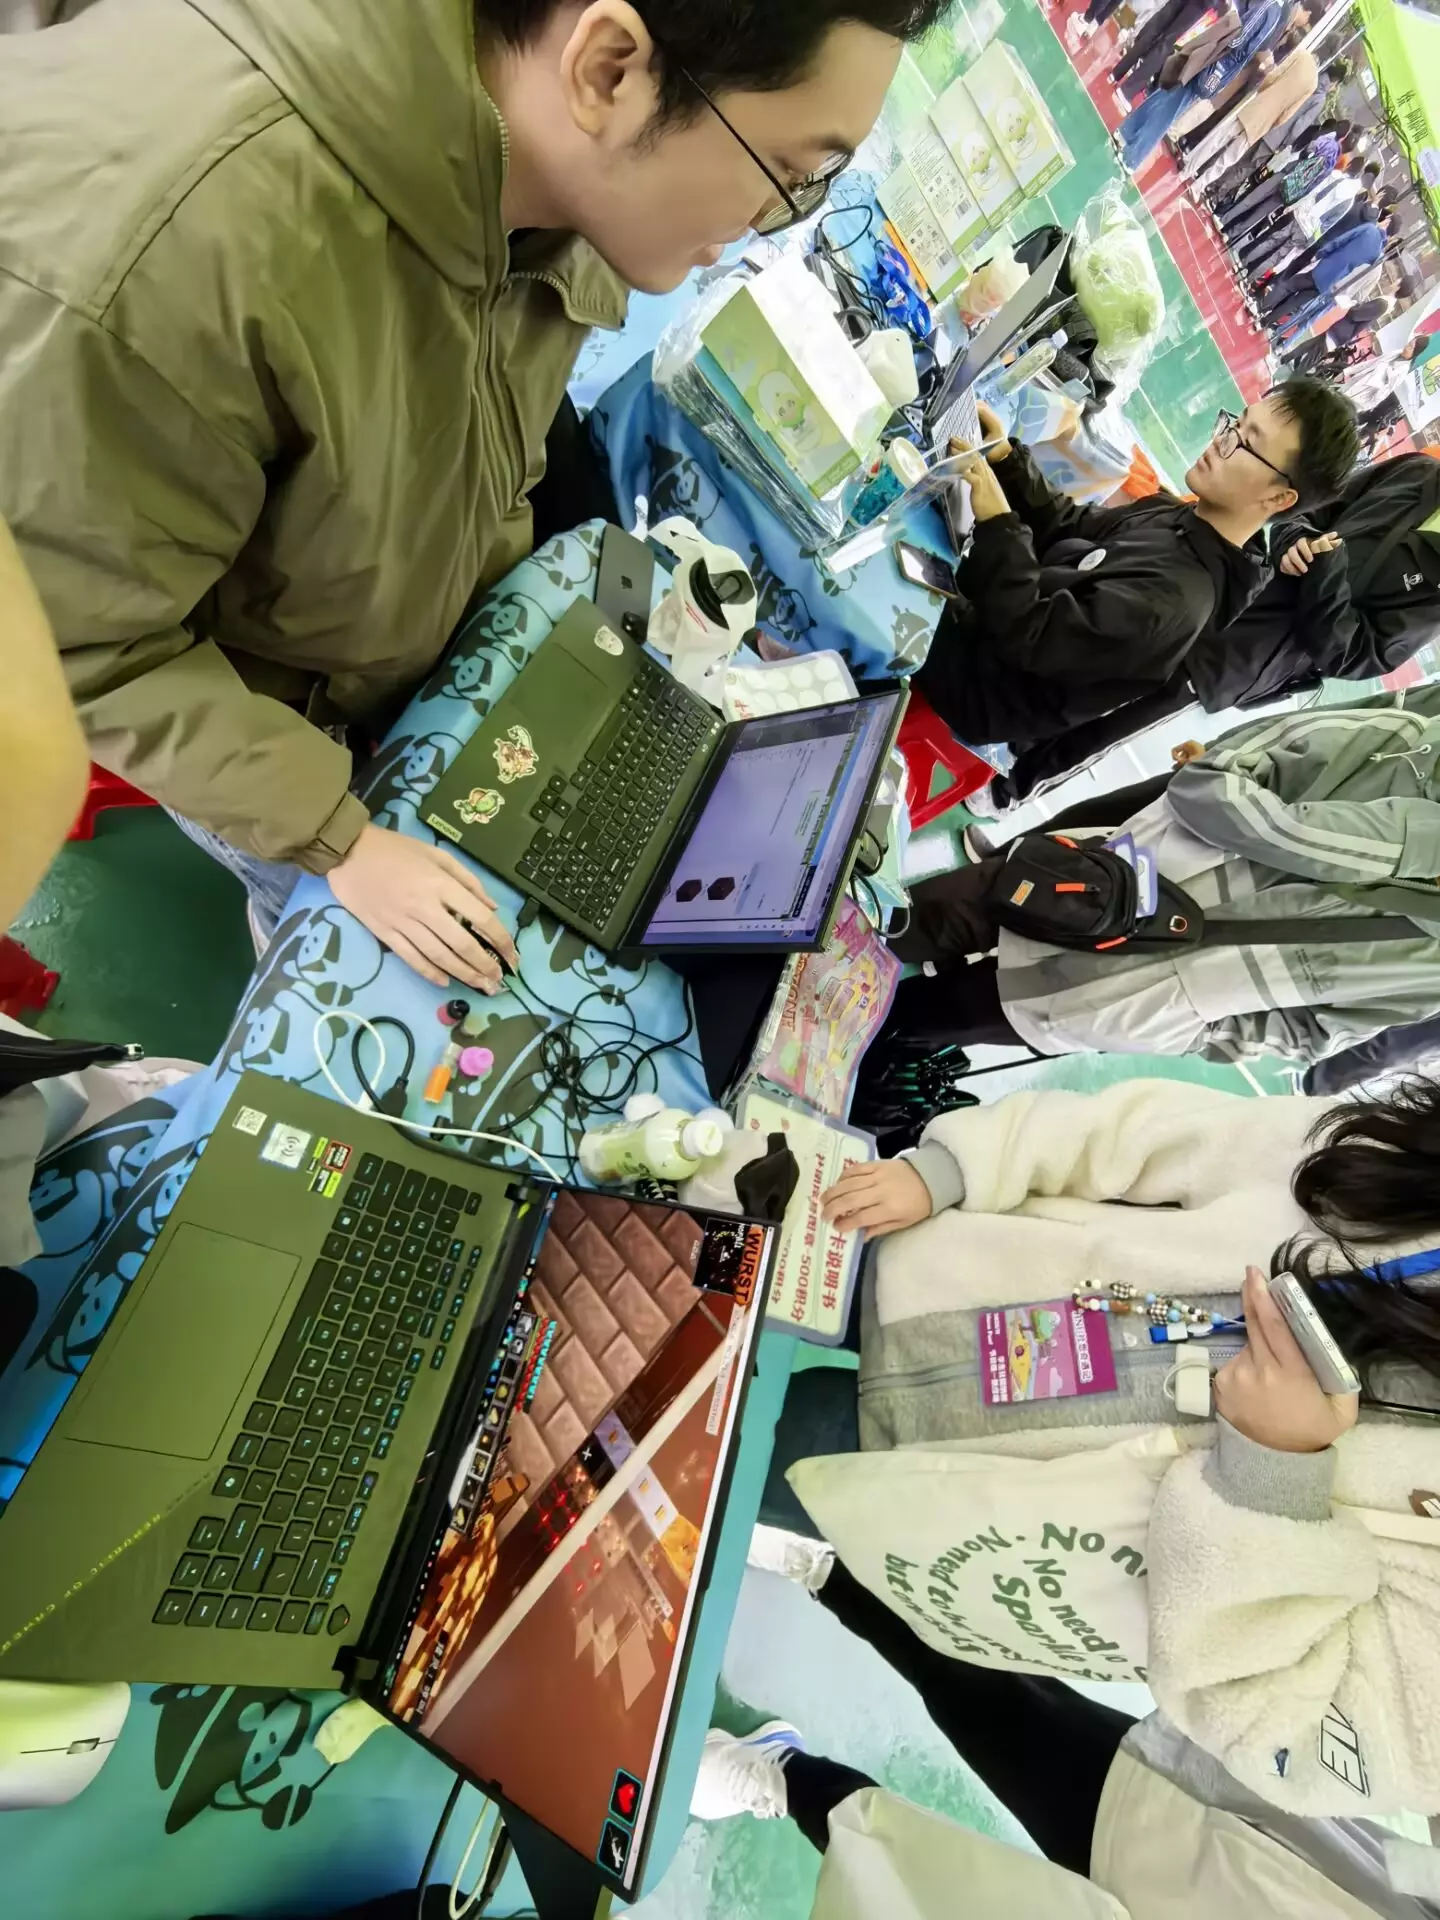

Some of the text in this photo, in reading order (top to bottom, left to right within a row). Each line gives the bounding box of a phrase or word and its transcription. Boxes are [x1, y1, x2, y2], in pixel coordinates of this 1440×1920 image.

[735, 1232, 762, 1303] WURST
[962, 1524, 1013, 1554] No
[1040, 1521, 1105, 1553] No
[884, 1552, 919, 1596] but
[928, 1546, 972, 1591] need
[1023, 1558, 1067, 1600] No
[1048, 1603, 1121, 1653] need
